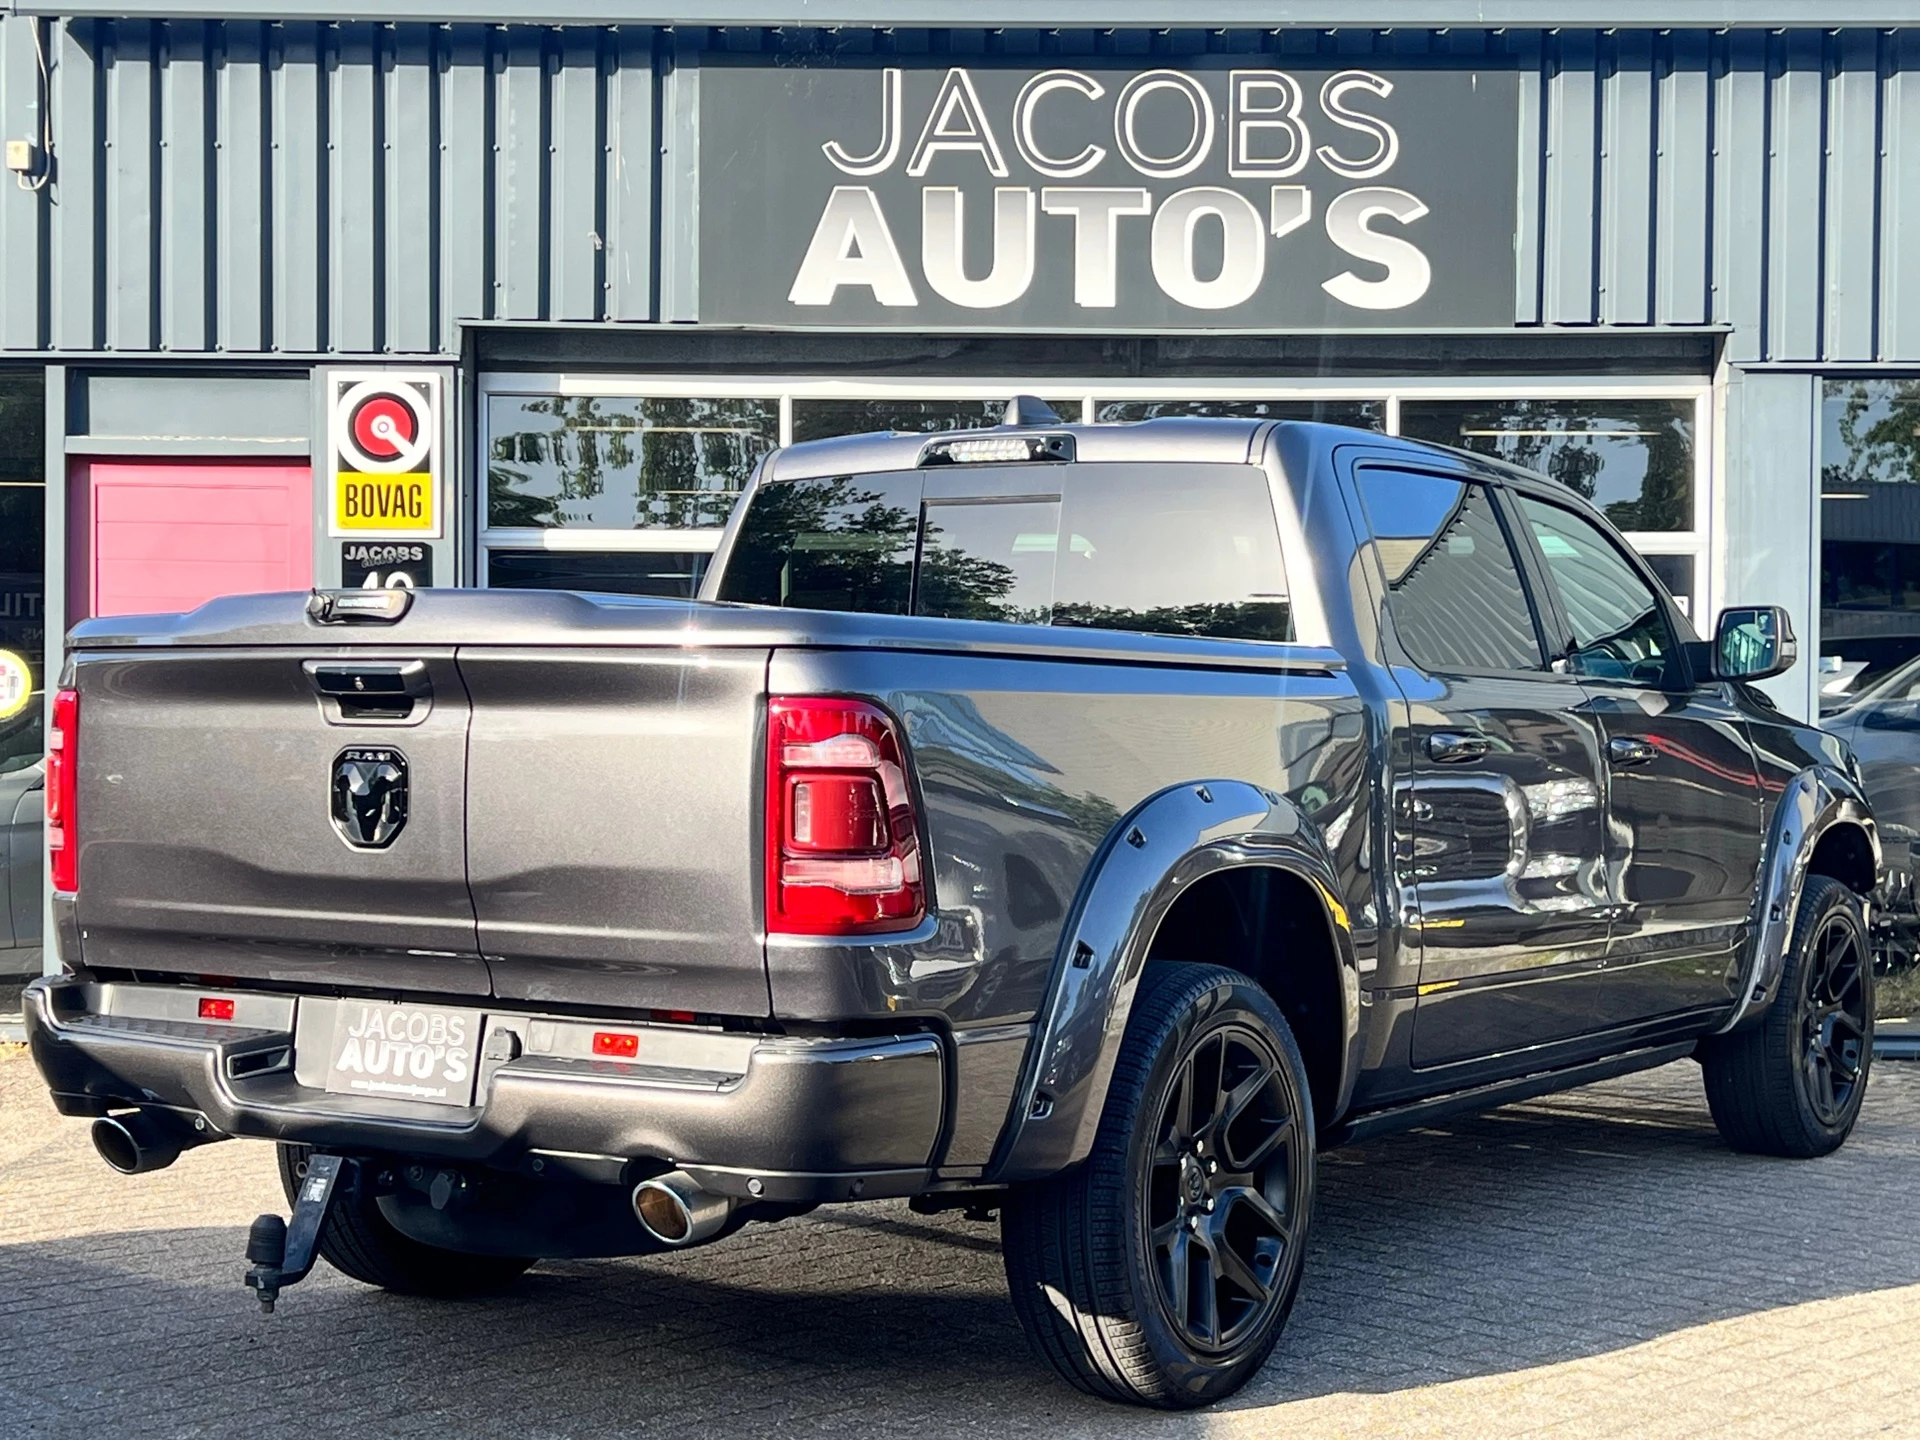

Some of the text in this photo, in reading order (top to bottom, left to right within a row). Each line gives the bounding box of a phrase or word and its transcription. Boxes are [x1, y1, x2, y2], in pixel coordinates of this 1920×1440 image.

[821, 67, 1400, 178] JACOBS
[788, 185, 1431, 310] AUTO'S
[346, 484, 422, 518] BOVAG
[344, 546, 423, 561] JACOBS
[345, 751, 391, 760] RAM
[348, 1007, 466, 1047] JACOBS
[336, 1038, 469, 1083] AUTO'S
